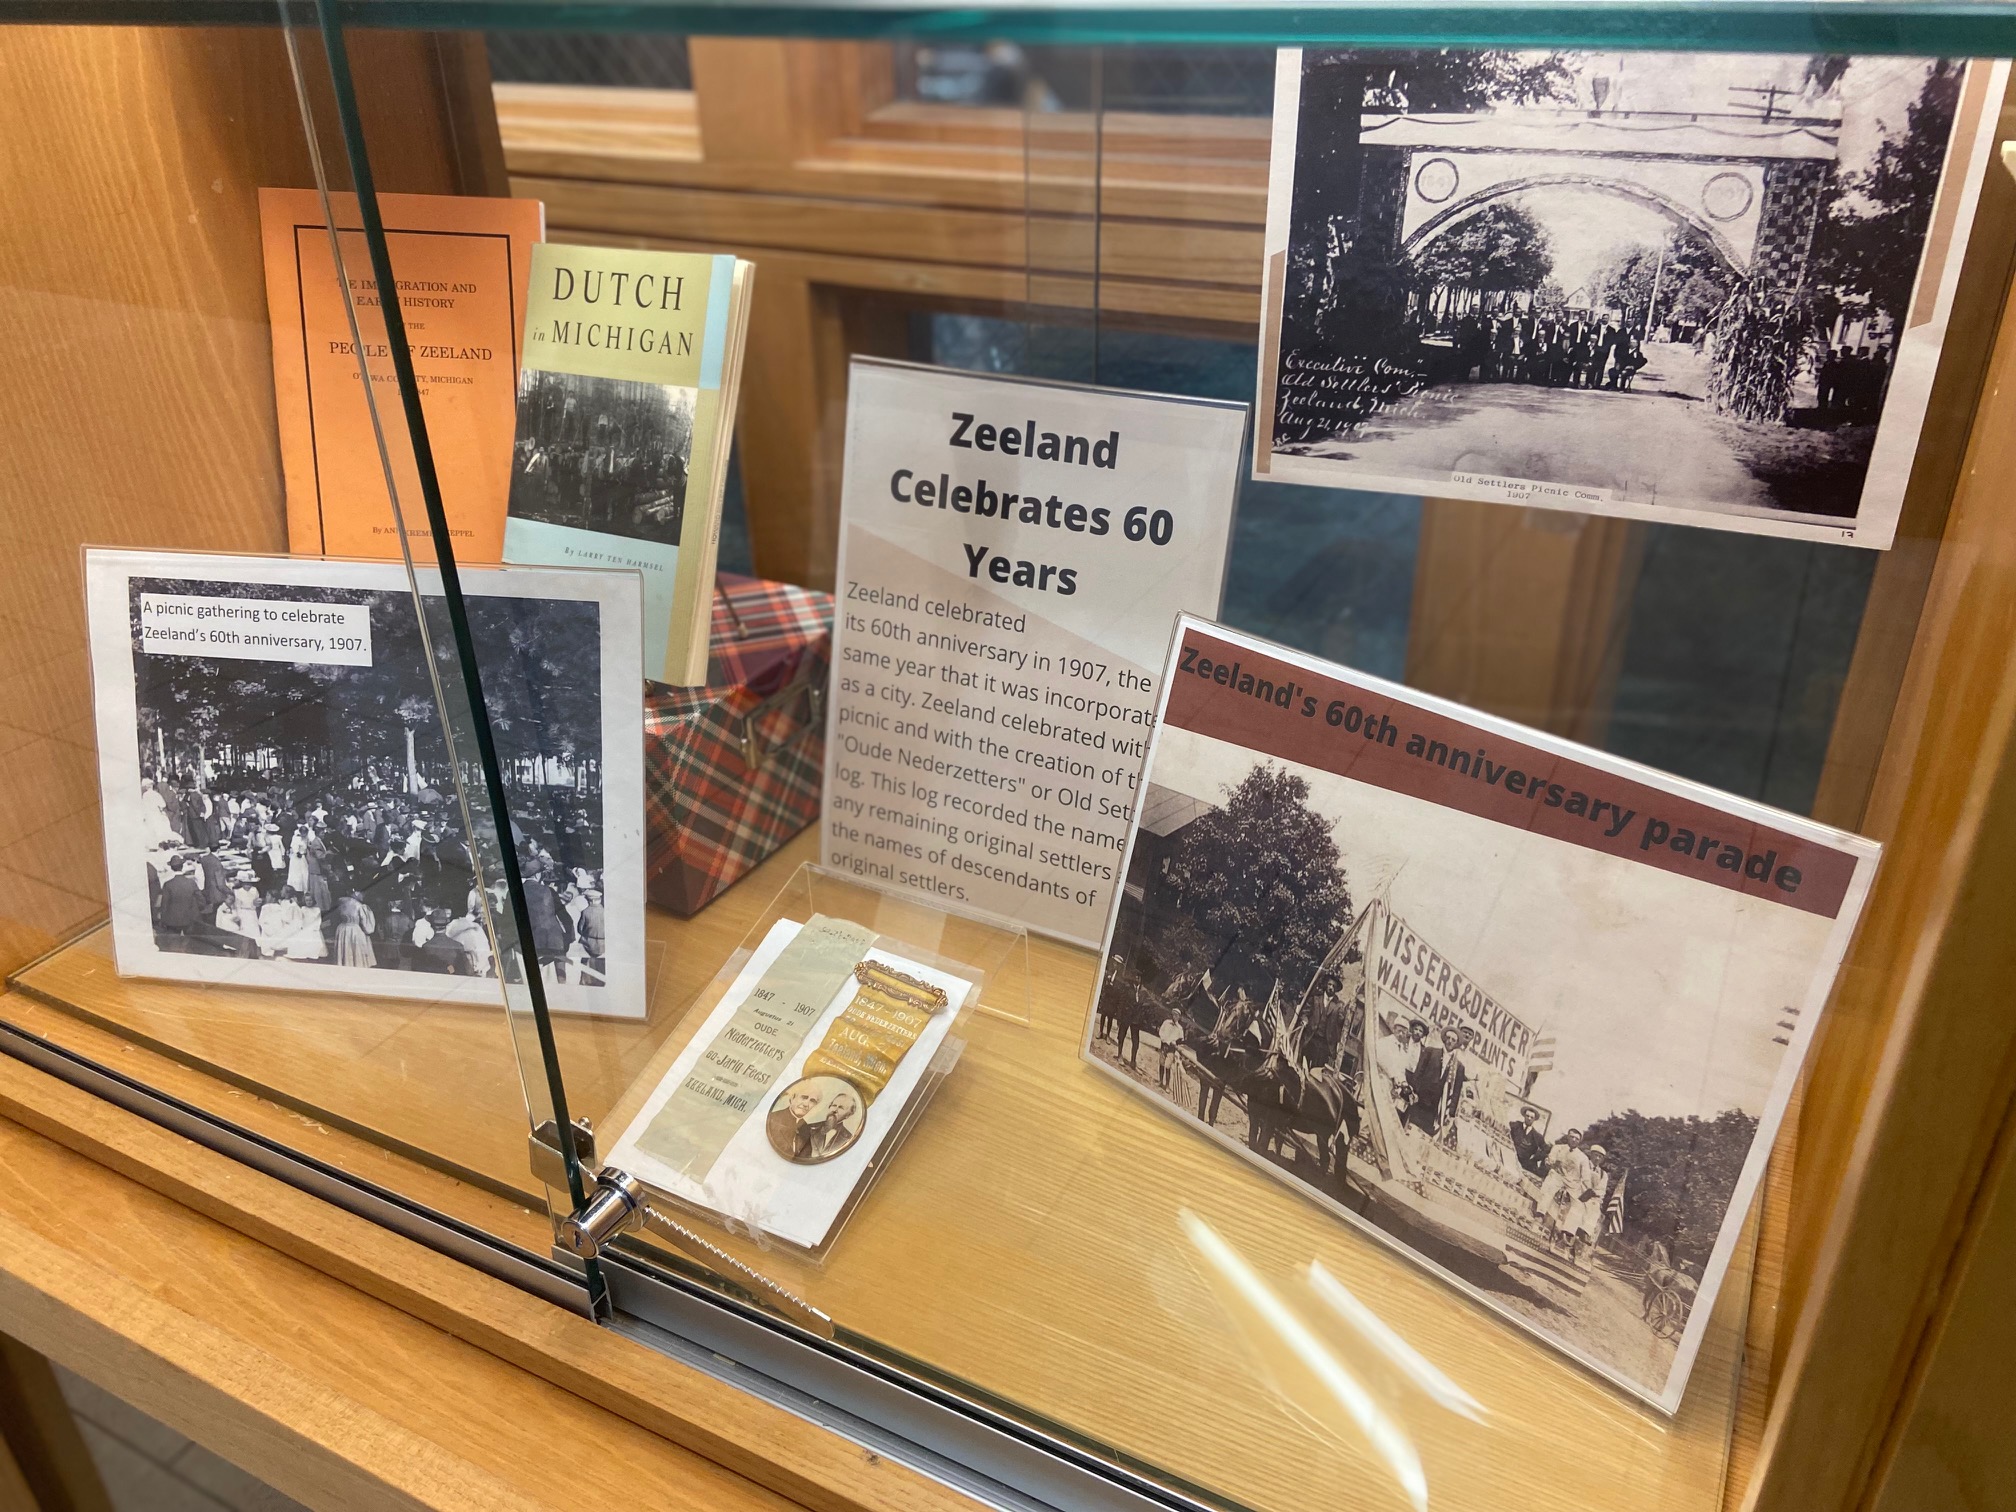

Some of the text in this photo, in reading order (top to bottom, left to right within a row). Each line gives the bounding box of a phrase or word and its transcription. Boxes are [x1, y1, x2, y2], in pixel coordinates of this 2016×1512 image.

[362, 280, 448, 292] IMGRATION
[451, 283, 477, 293] AND
[403, 297, 455, 309] HISTORY
[553, 267, 684, 311] DUTCH
[329, 341, 388, 358] PEOLE
[420, 346, 492, 361] ZEELAND
[532, 320, 694, 356] in MICHIGAN
[430, 376, 474, 384] MICHIGAN
[949, 412, 1120, 470] Zeeland
[890, 468, 1174, 546] Celebrates 60
[1453, 475, 1604, 502] Old Settlers Picnic Comm.
[1507, 491, 1531, 500] 1907
[578, 550, 603, 560] LARRY
[607, 555, 622, 564] TEN
[626, 558, 664, 572] HARMSEL
[963, 543, 1078, 596] Years
[143, 601, 345, 625] A picnic gathering to celebrate
[847, 581, 1026, 634] Zeeland celebrated
[144, 626, 367, 652] Zeeland's 60th anniversary, 1907.
[845, 612, 1152, 693] its 60th anniversary in 1907, the
[843, 647, 891, 670] same
[895, 656, 936, 678] year
[941, 665, 979, 689] that
[984, 672, 996, 692] it
[1001, 682, 1039, 702] was
[840, 676, 860, 693] as
[865, 682, 875, 697] a
[880, 684, 916, 708] city.
[921, 692, 996, 725] Zeeland
[1001, 710, 1106, 750] celebrated
[839, 705, 890, 732] picnic
[894, 715, 929, 740] and
[933, 725, 973, 751] with
[978, 733, 1009, 759] the
[1015, 747, 1095, 780] creation
[1101, 768, 1124, 786] of
[837, 733, 893, 761] "Oude
[897, 748, 1026, 793] Nederzetters"
[1031, 784, 1052, 801] or
[1057, 787, 1092, 813] Old
[1179, 646, 1802, 893] Zeeland's 60th anniversary parade
[835, 762, 866, 788] log.
[871, 771, 907, 797] This
[911, 785, 938, 809] log
[943, 795, 1028, 828] recorded
[1033, 813, 1066, 837] the
[833, 795, 864, 817] any
[868, 805, 959, 844] remaining
[964, 831, 1034, 861] original
[1039, 847, 1112, 881] settlers
[831, 820, 1097, 908] the names of descendants of
[831, 850, 970, 902] original settlers.
[753, 988, 776, 1002] 1847
[793, 1002, 816, 1017] 1907
[847, 1007, 866, 1018] OUDE
[724, 1027, 785, 1062] Nederzetters
[754, 1022, 779, 1037] OUDE
[743, 1064, 772, 1085] Feest
[1472, 1031, 1516, 1077] PAINTS
